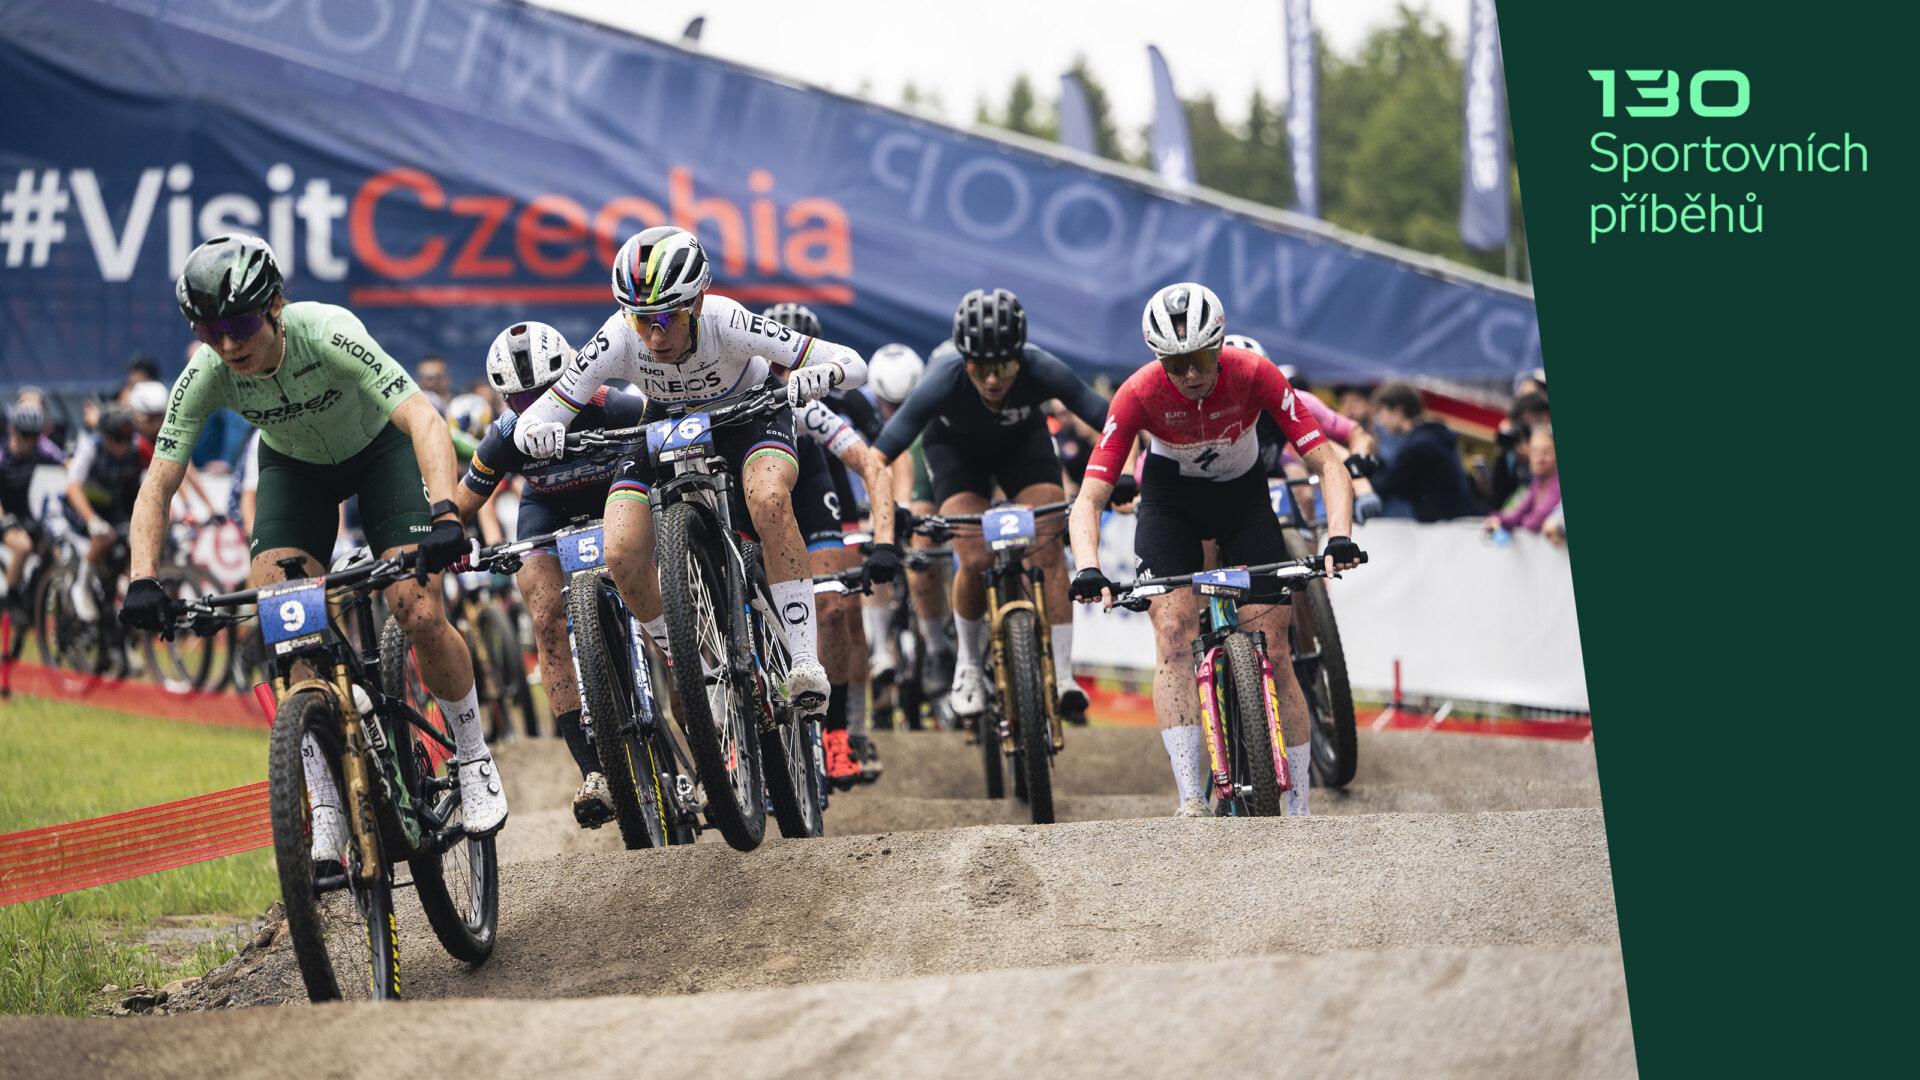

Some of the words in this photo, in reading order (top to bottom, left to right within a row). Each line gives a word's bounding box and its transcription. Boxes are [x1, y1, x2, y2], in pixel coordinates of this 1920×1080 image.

[729, 309, 792, 342] INEOS
[564, 331, 609, 386] INEOS
[381, 375, 407, 399] FOX
[644, 371, 721, 393] INEOS
[241, 388, 339, 420] ORBEA
[250, 412, 304, 426] ACTORY
[658, 418, 702, 444] 16
[766, 430, 790, 441] GOBIK
[581, 465, 618, 483] RACIN
[999, 514, 1020, 536] 2
[578, 537, 600, 563] 5
[279, 600, 306, 632] 9
